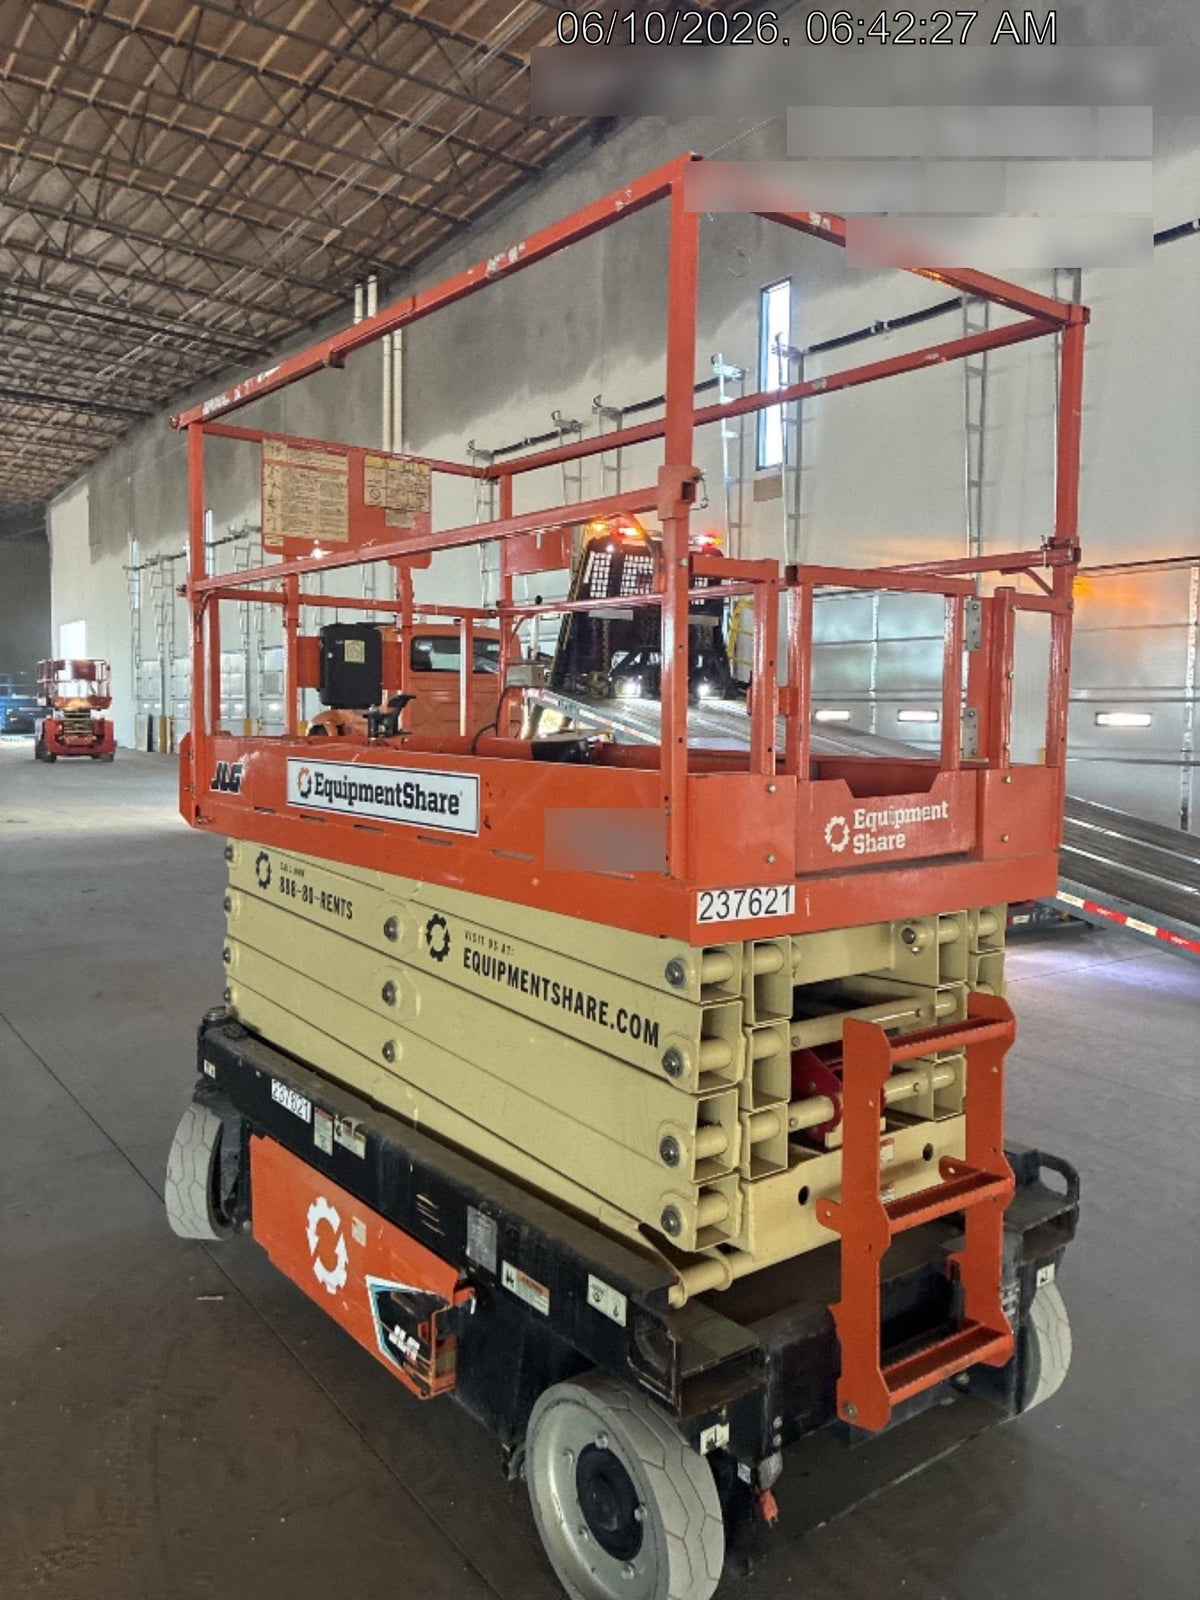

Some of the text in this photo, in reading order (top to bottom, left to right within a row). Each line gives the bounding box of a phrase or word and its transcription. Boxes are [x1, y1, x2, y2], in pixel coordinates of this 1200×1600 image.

[211, 761, 243, 793] JLG
[314, 771, 460, 815] EquipmentShare
[853, 800, 949, 831] Equipment
[853, 832, 906, 855] Share
[698, 886, 792, 922] 237621
[463, 947, 660, 1048] EQUIPMENTSHARE.COM
